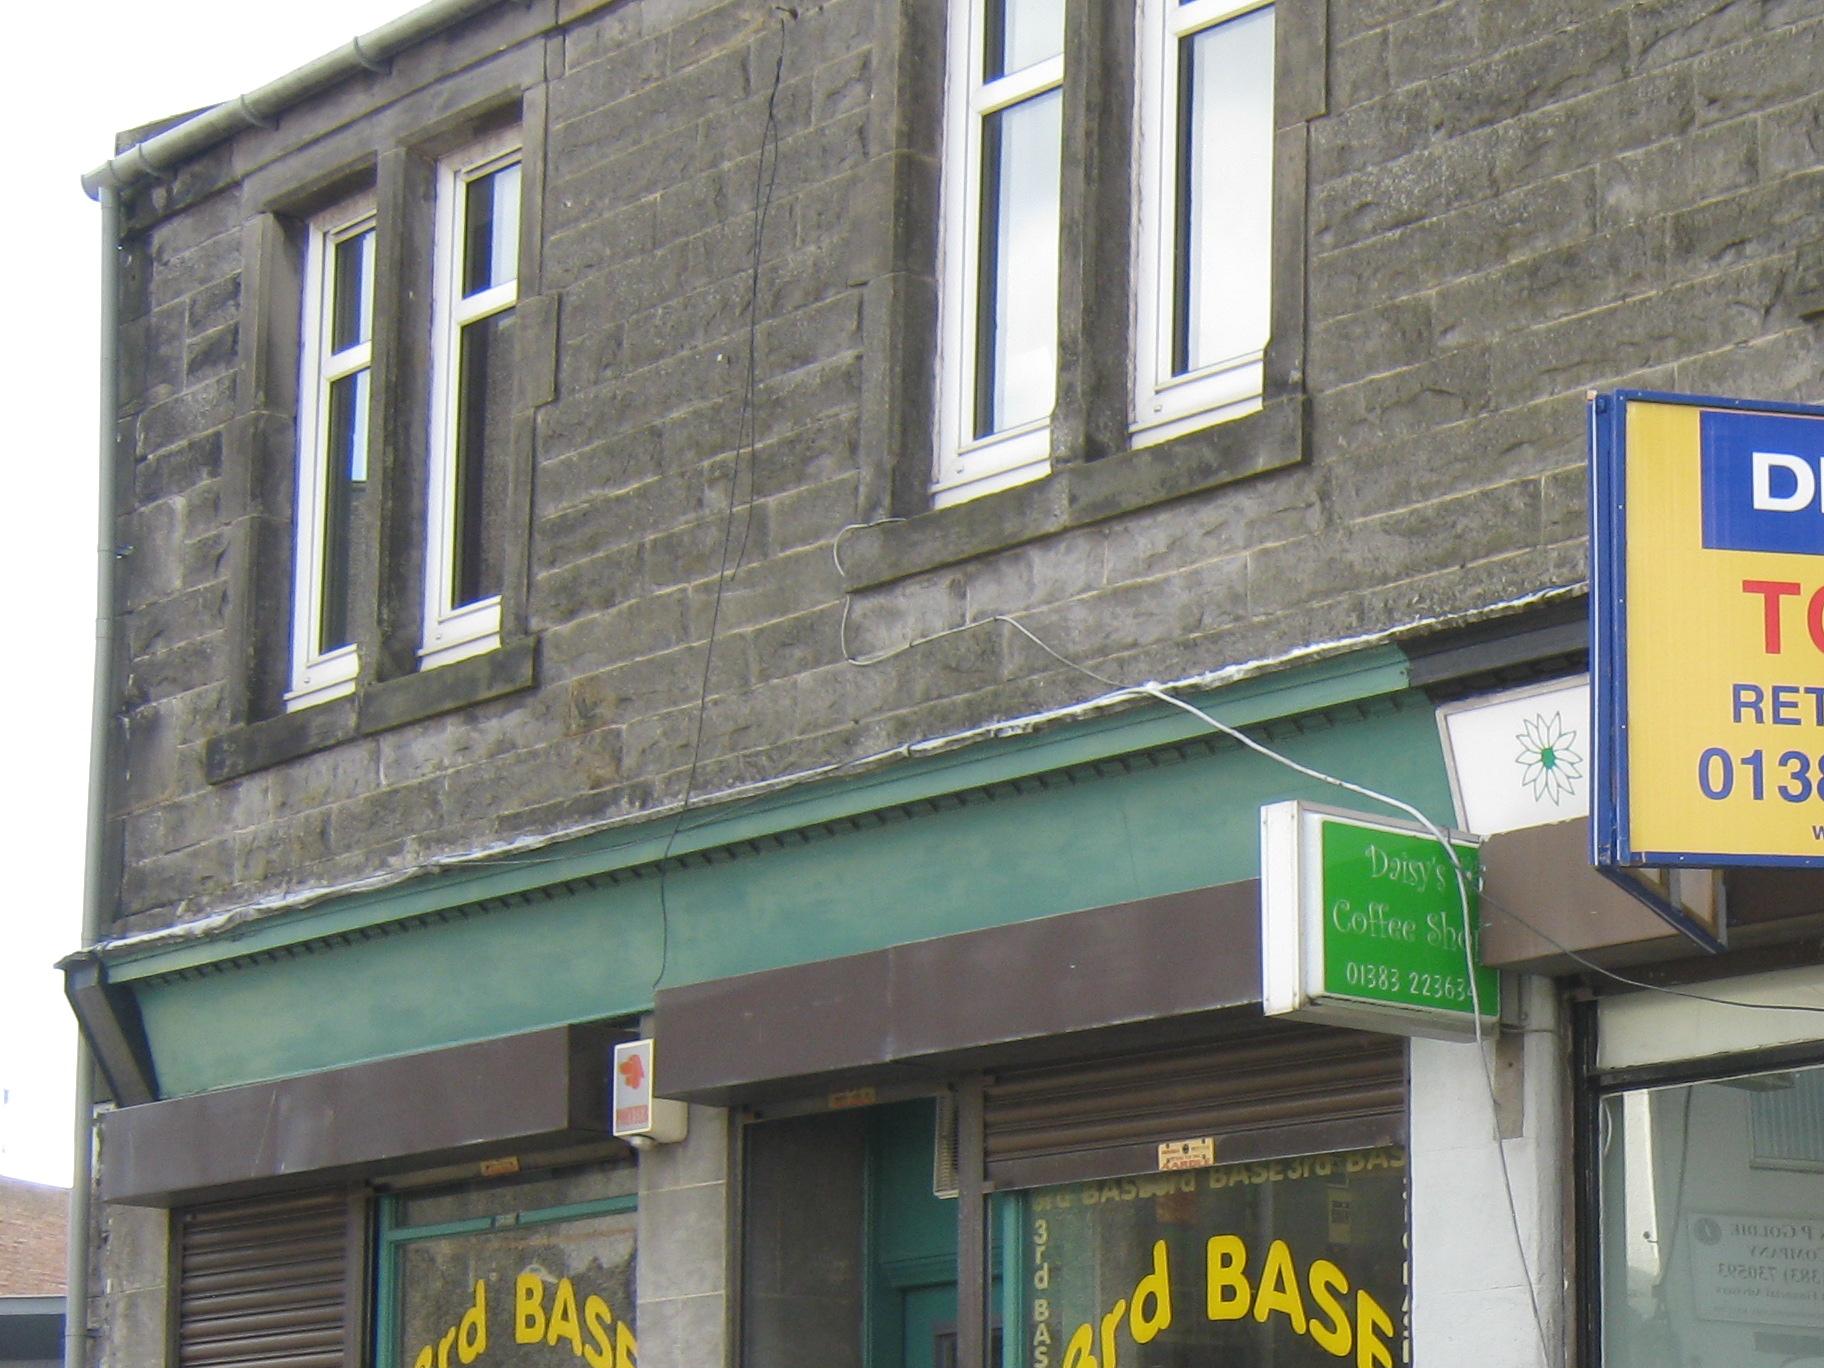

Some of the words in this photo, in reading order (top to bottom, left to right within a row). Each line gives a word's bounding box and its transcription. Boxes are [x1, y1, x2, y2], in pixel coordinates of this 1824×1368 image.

[1365, 844, 1446, 893] Daisy's
[1332, 899, 1416, 943] Coffee
[1346, 962, 1400, 992] 01383
